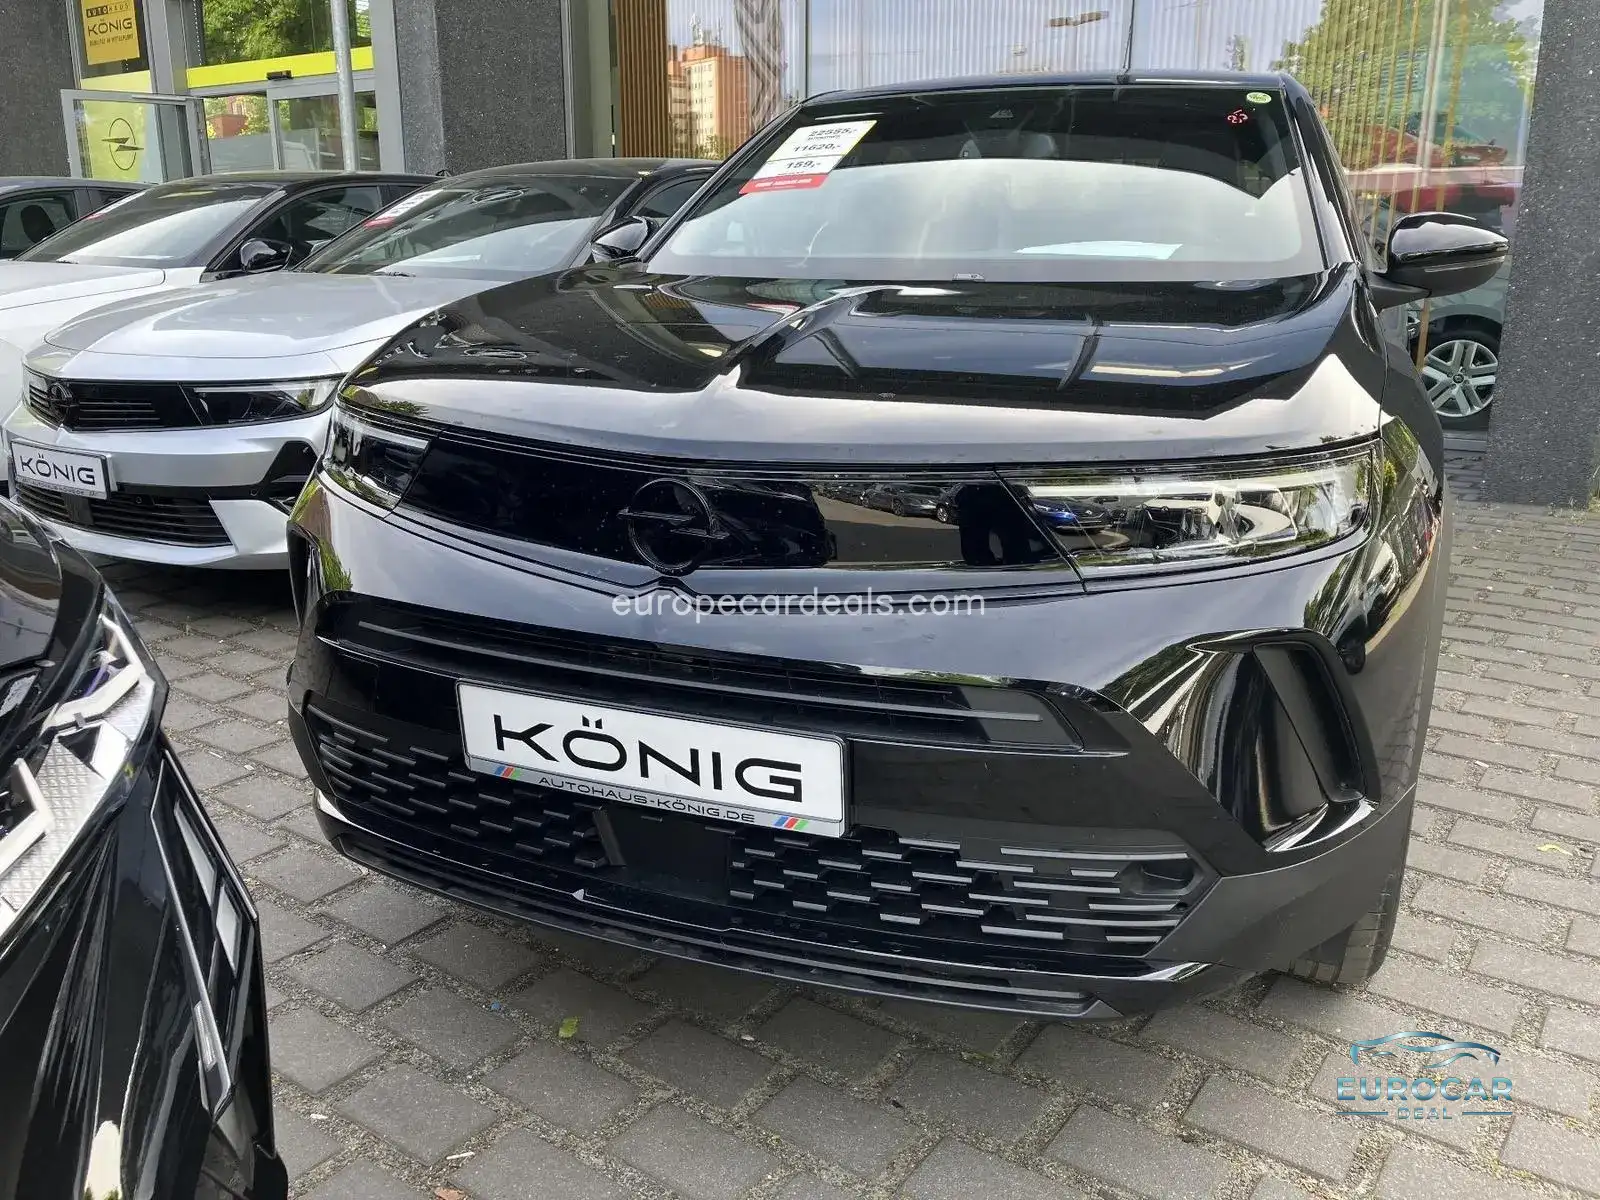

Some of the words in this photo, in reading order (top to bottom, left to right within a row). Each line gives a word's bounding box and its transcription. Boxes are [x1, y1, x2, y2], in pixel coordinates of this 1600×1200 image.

[87, 18, 133, 36] KÖNIG
[20, 453, 96, 485] KÖNIG
[493, 714, 803, 803] KÖNIG
[538, 776, 756, 824] AUTOHAUS-KÖNIG.DE
